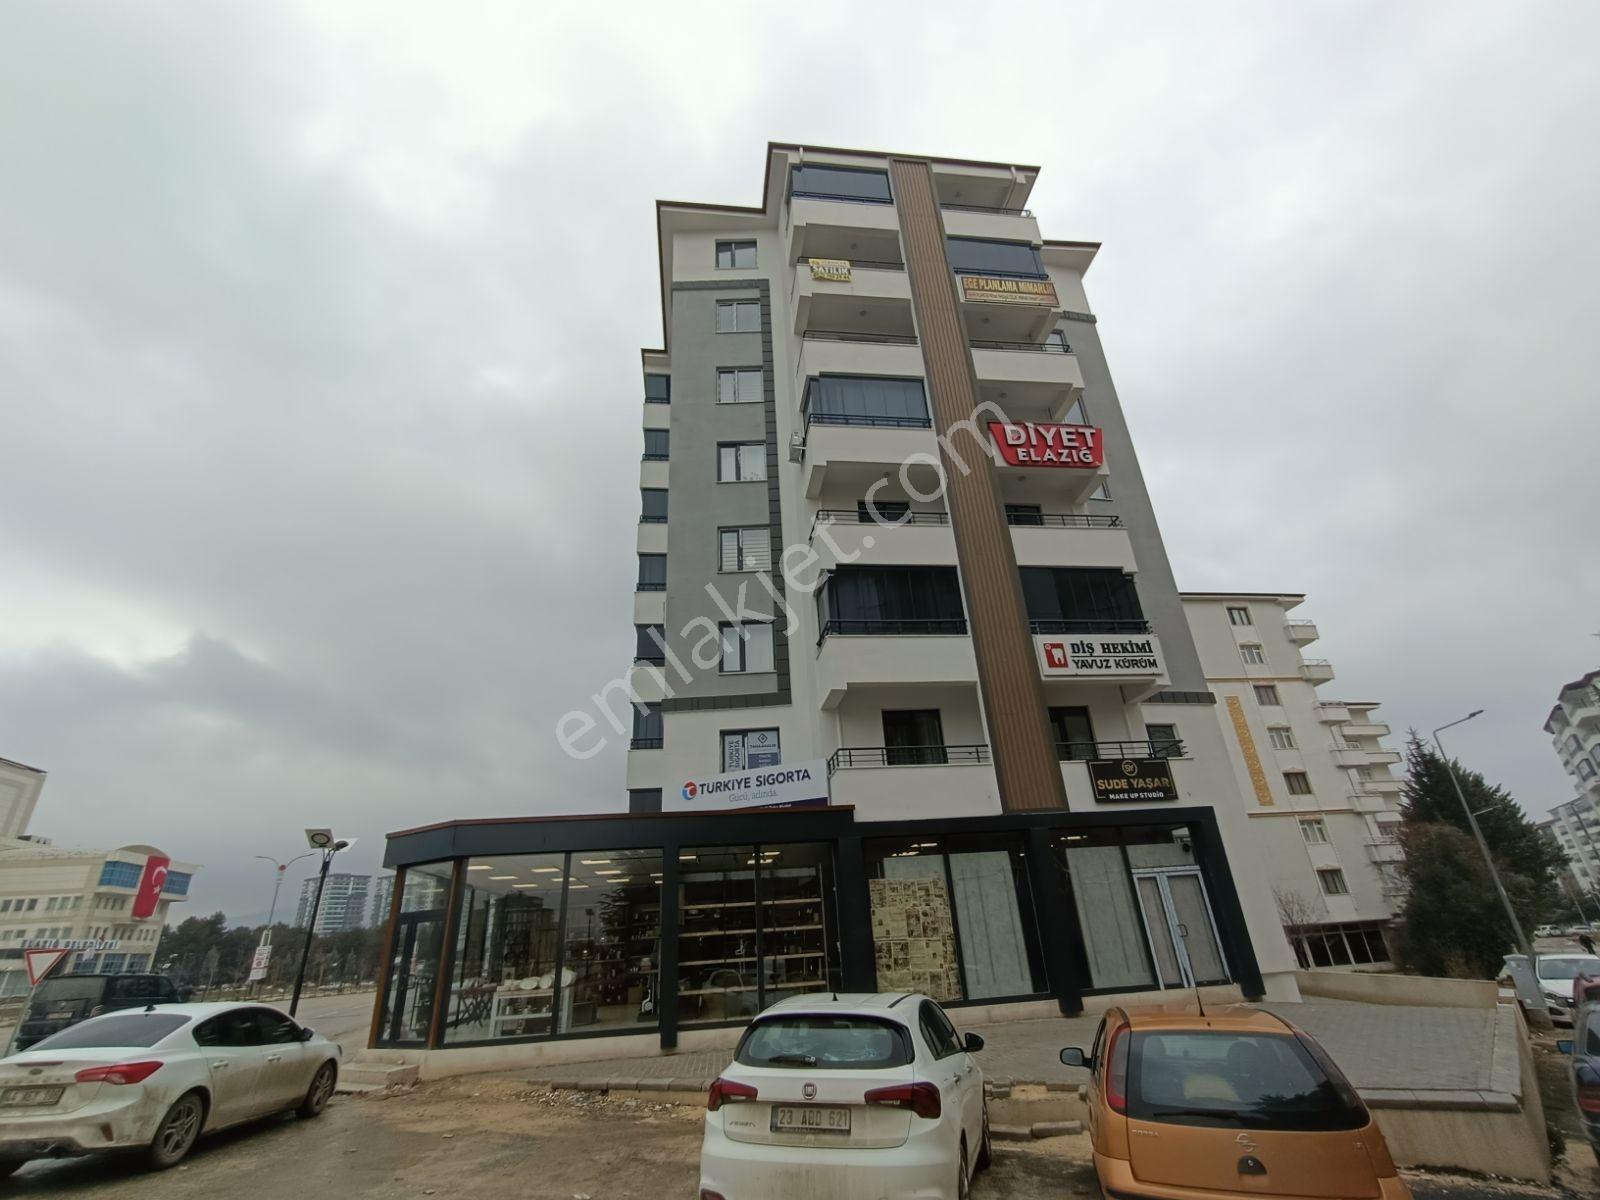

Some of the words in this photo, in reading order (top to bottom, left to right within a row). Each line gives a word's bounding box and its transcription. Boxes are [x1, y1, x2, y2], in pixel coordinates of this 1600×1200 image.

[964, 277, 978, 289] EGE
[979, 279, 1018, 292] PLANLAMA
[1003, 422, 1096, 448] DİYET
[1017, 446, 1094, 463] ELAZIĞ
[1070, 640, 1095, 657] DİŞ
[1100, 640, 1154, 654] HEKİMİ
[1071, 658, 1112, 669] YAVUZ
[1115, 657, 1158, 669] KÜRÜM
[1097, 779, 1129, 790] SUDE
[779, 1109, 793, 1125] 23
[829, 1111, 847, 1128] 621
